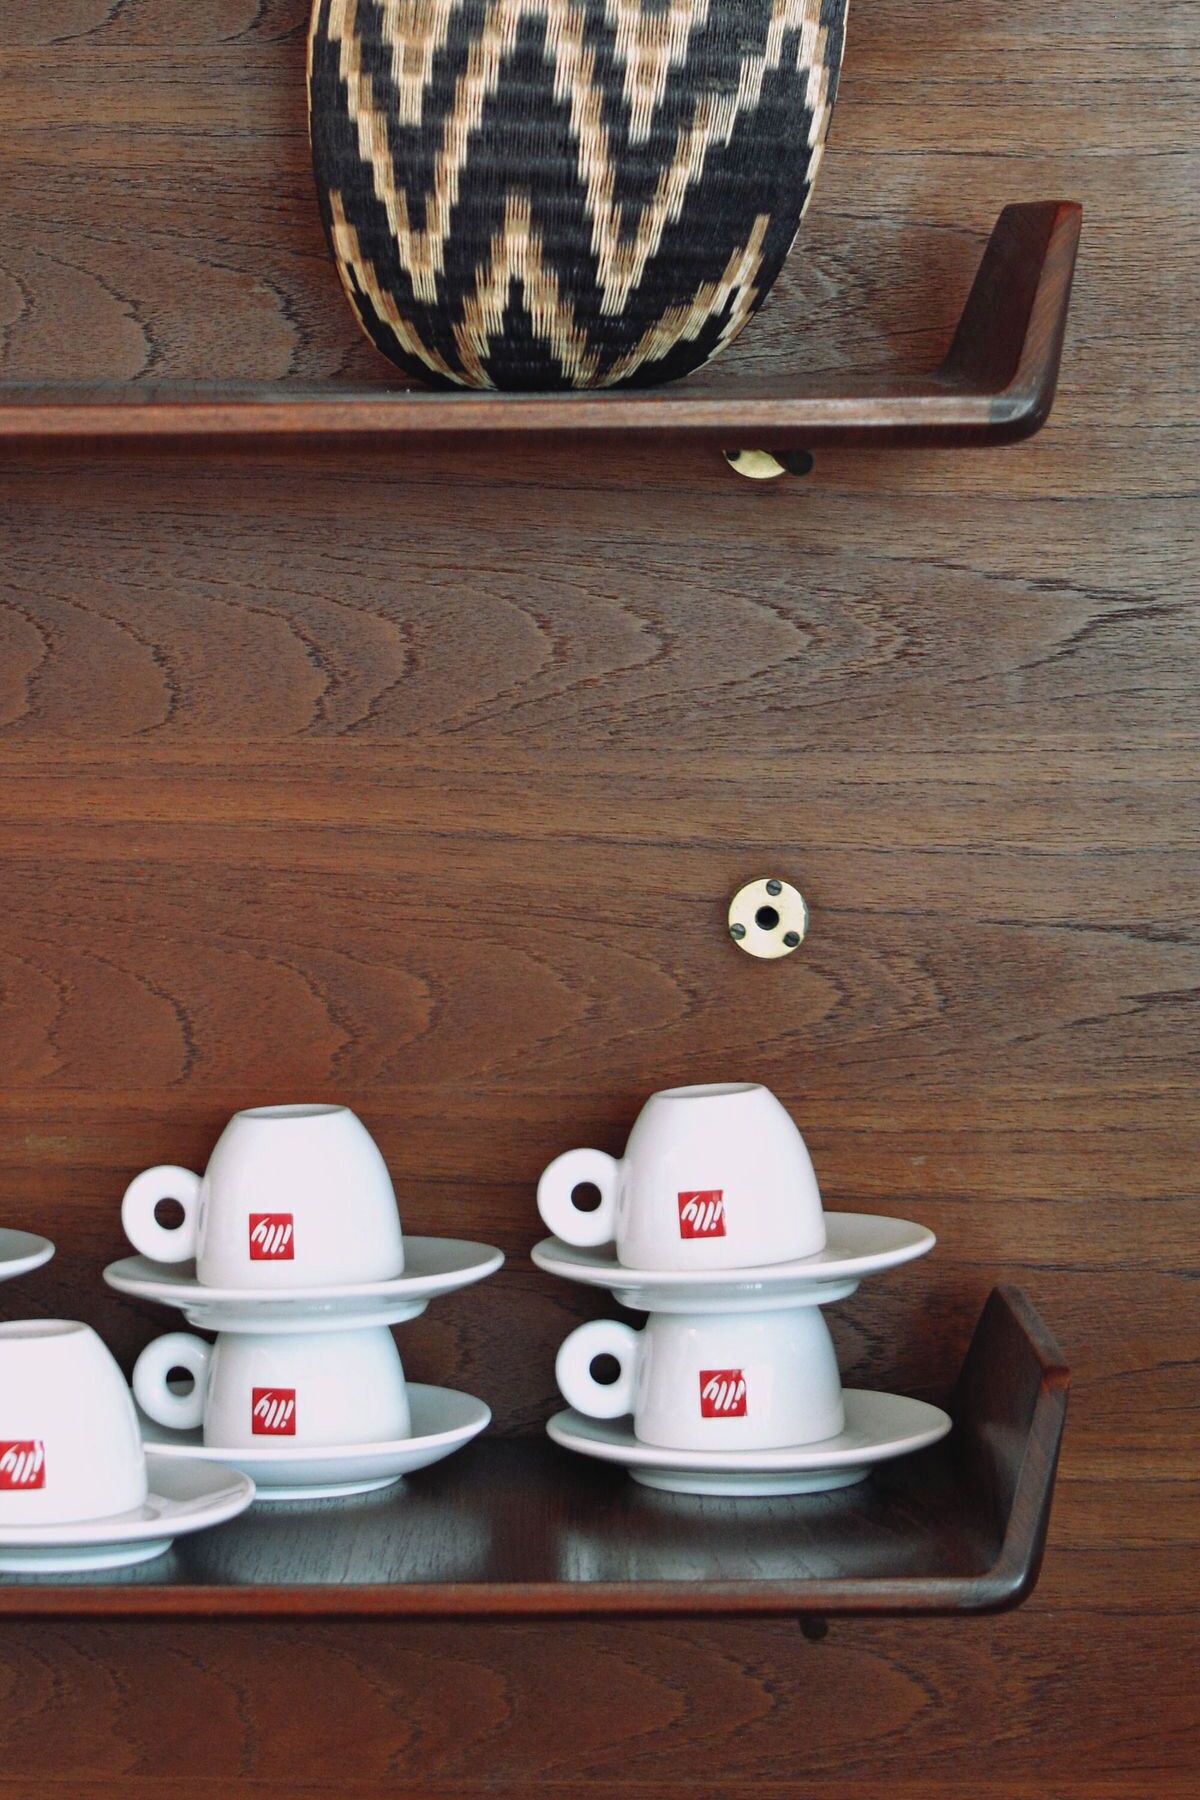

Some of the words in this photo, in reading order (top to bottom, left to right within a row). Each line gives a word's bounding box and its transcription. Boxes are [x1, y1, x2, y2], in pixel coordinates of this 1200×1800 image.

[681, 1194, 723, 1231] illy
[251, 1218, 292, 1253] illy
[254, 1392, 294, 1428] illy
[702, 1375, 745, 1410] illy
[0, 1444, 43, 1483] illy
